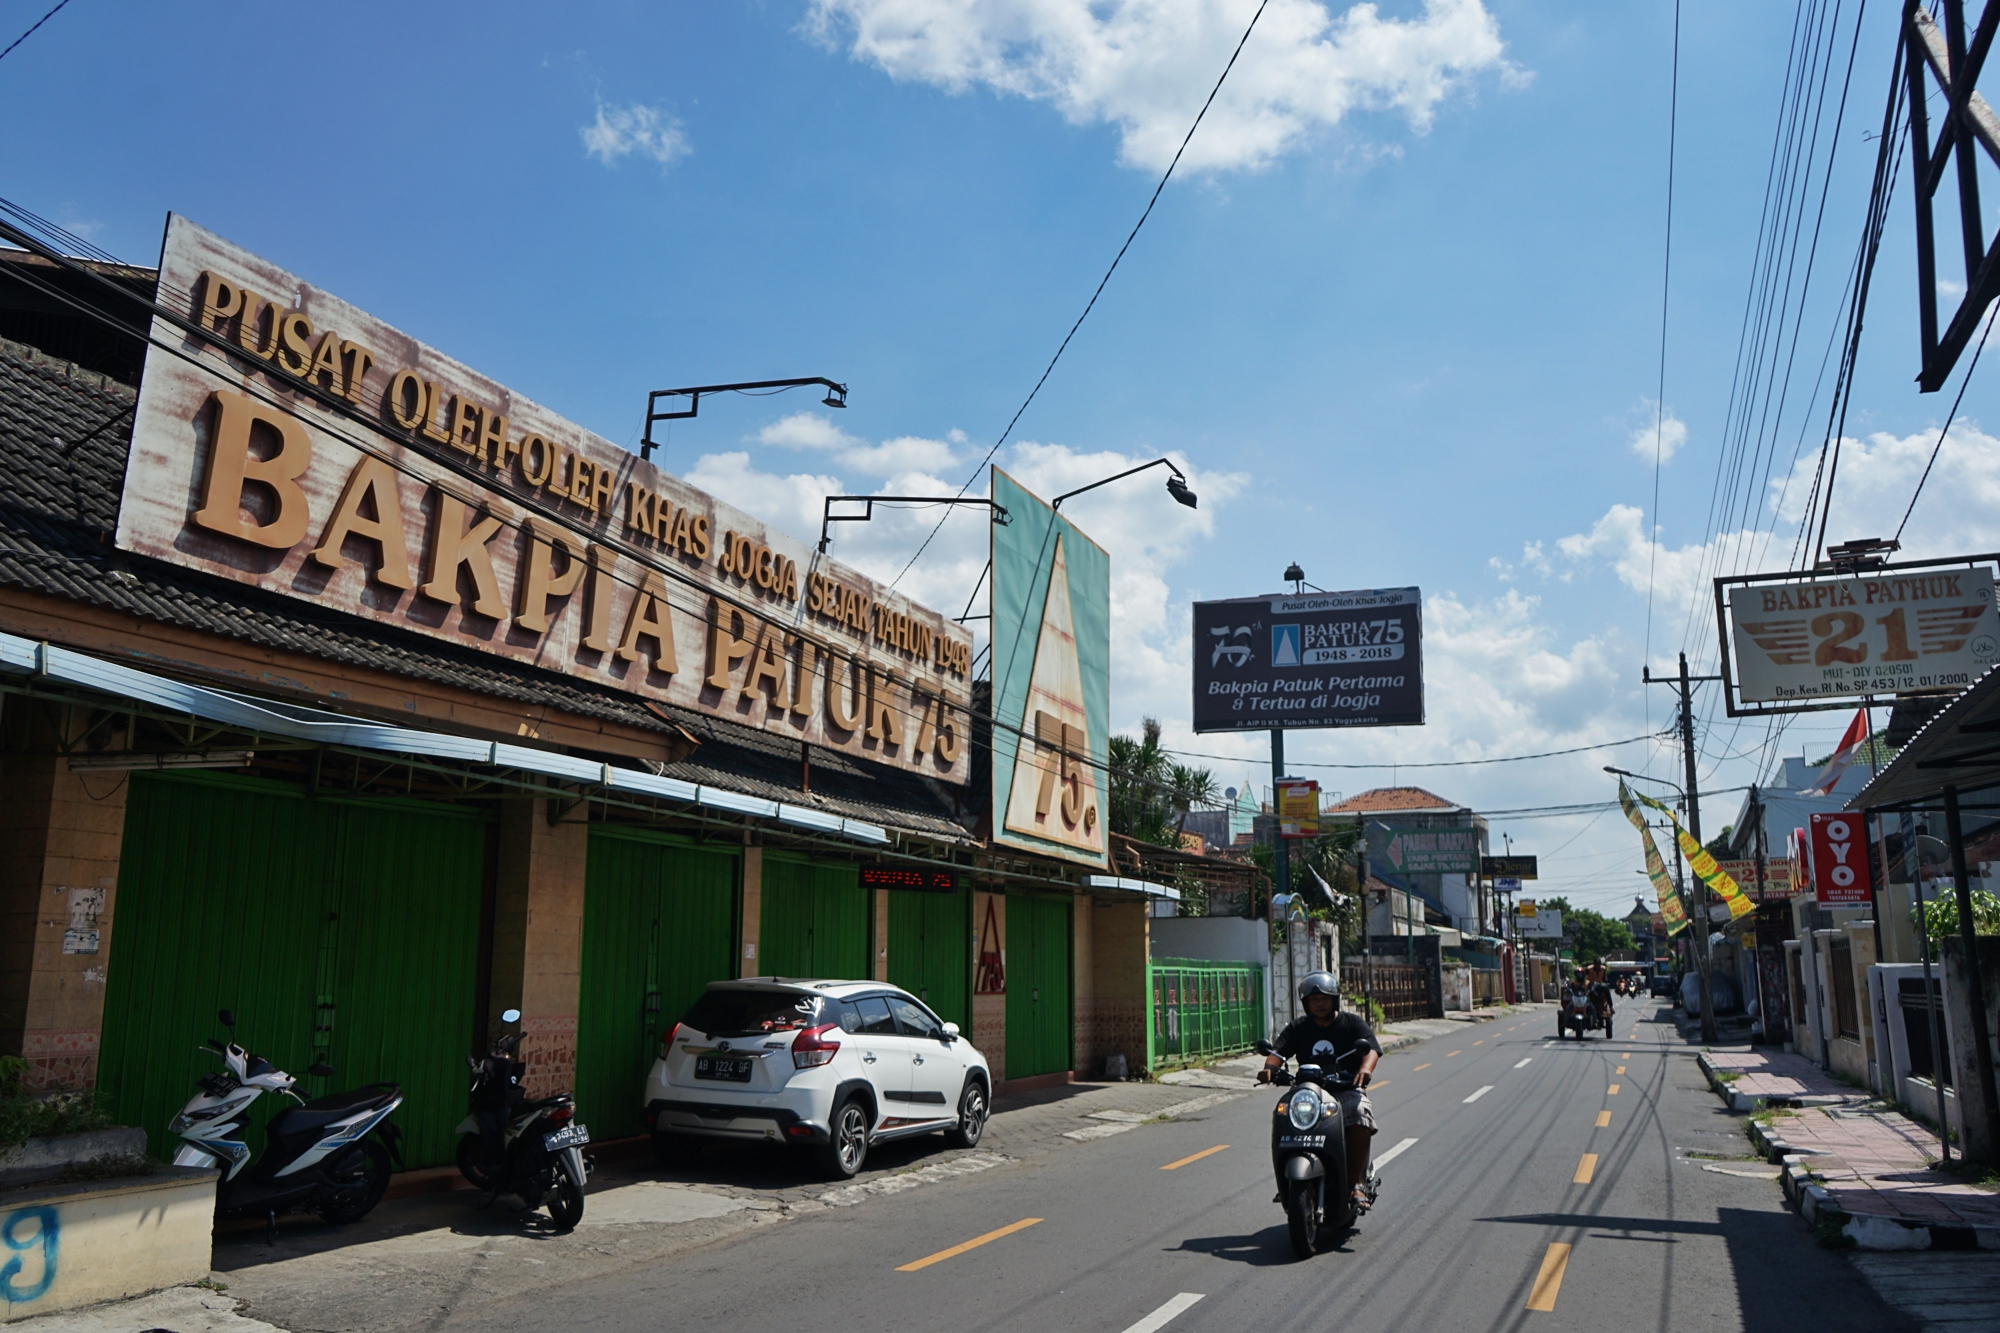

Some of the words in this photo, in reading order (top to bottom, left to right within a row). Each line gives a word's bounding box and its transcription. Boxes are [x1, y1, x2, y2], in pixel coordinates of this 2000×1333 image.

[200, 270, 376, 404] PUSAT
[387, 369, 616, 518] OLEH-OLEH
[627, 482, 710, 560] KHAS
[721, 530, 798, 602] JOGJA
[807, 571, 871, 633] SEJAK
[872, 603, 931, 660] TAHUN
[936, 633, 969, 676] 1948
[190, 389, 679, 675] BAKPIA
[706, 596, 903, 746] PATUK
[911, 677, 963, 763] 75
[1281, 601, 1306, 611] Pusat
[1308, 598, 1353, 609] Oleh-Oleh
[1355, 596, 1378, 606] Khas
[1378, 593, 1403, 604] Jogja
[1760, 584, 1856, 613] BAKPIA
[1863, 573, 1963, 604] PATHUK
[1304, 621, 1370, 638] BAKPIA
[1369, 618, 1404, 644] 75
[1304, 632, 1371, 649] PATUK
[1811, 608, 1918, 666] 21
[1314, 649, 1348, 661] 1948
[1359, 647, 1392, 659] 2018
[1875, 663, 1913, 675] 020501
[1208, 679, 1269, 697] Bakpia
[1272, 677, 1324, 693] Patuk
[1328, 675, 1405, 690] Pertama
[1232, 698, 1244, 710] &
[1249, 695, 1306, 711] Tertua
[1310, 694, 1327, 708] di
[1331, 693, 1380, 711] Jogja
[1283, 718, 1307, 726] Tubun
[1334, 716, 1379, 726] Yogyakarta
[1034, 709, 1087, 825] 75
[1438, 832, 1474, 851] BAKPIA
[1826, 820, 1855, 887] OYO
[697, 1060, 709, 1071] AB
[715, 1060, 733, 1072] 1224
